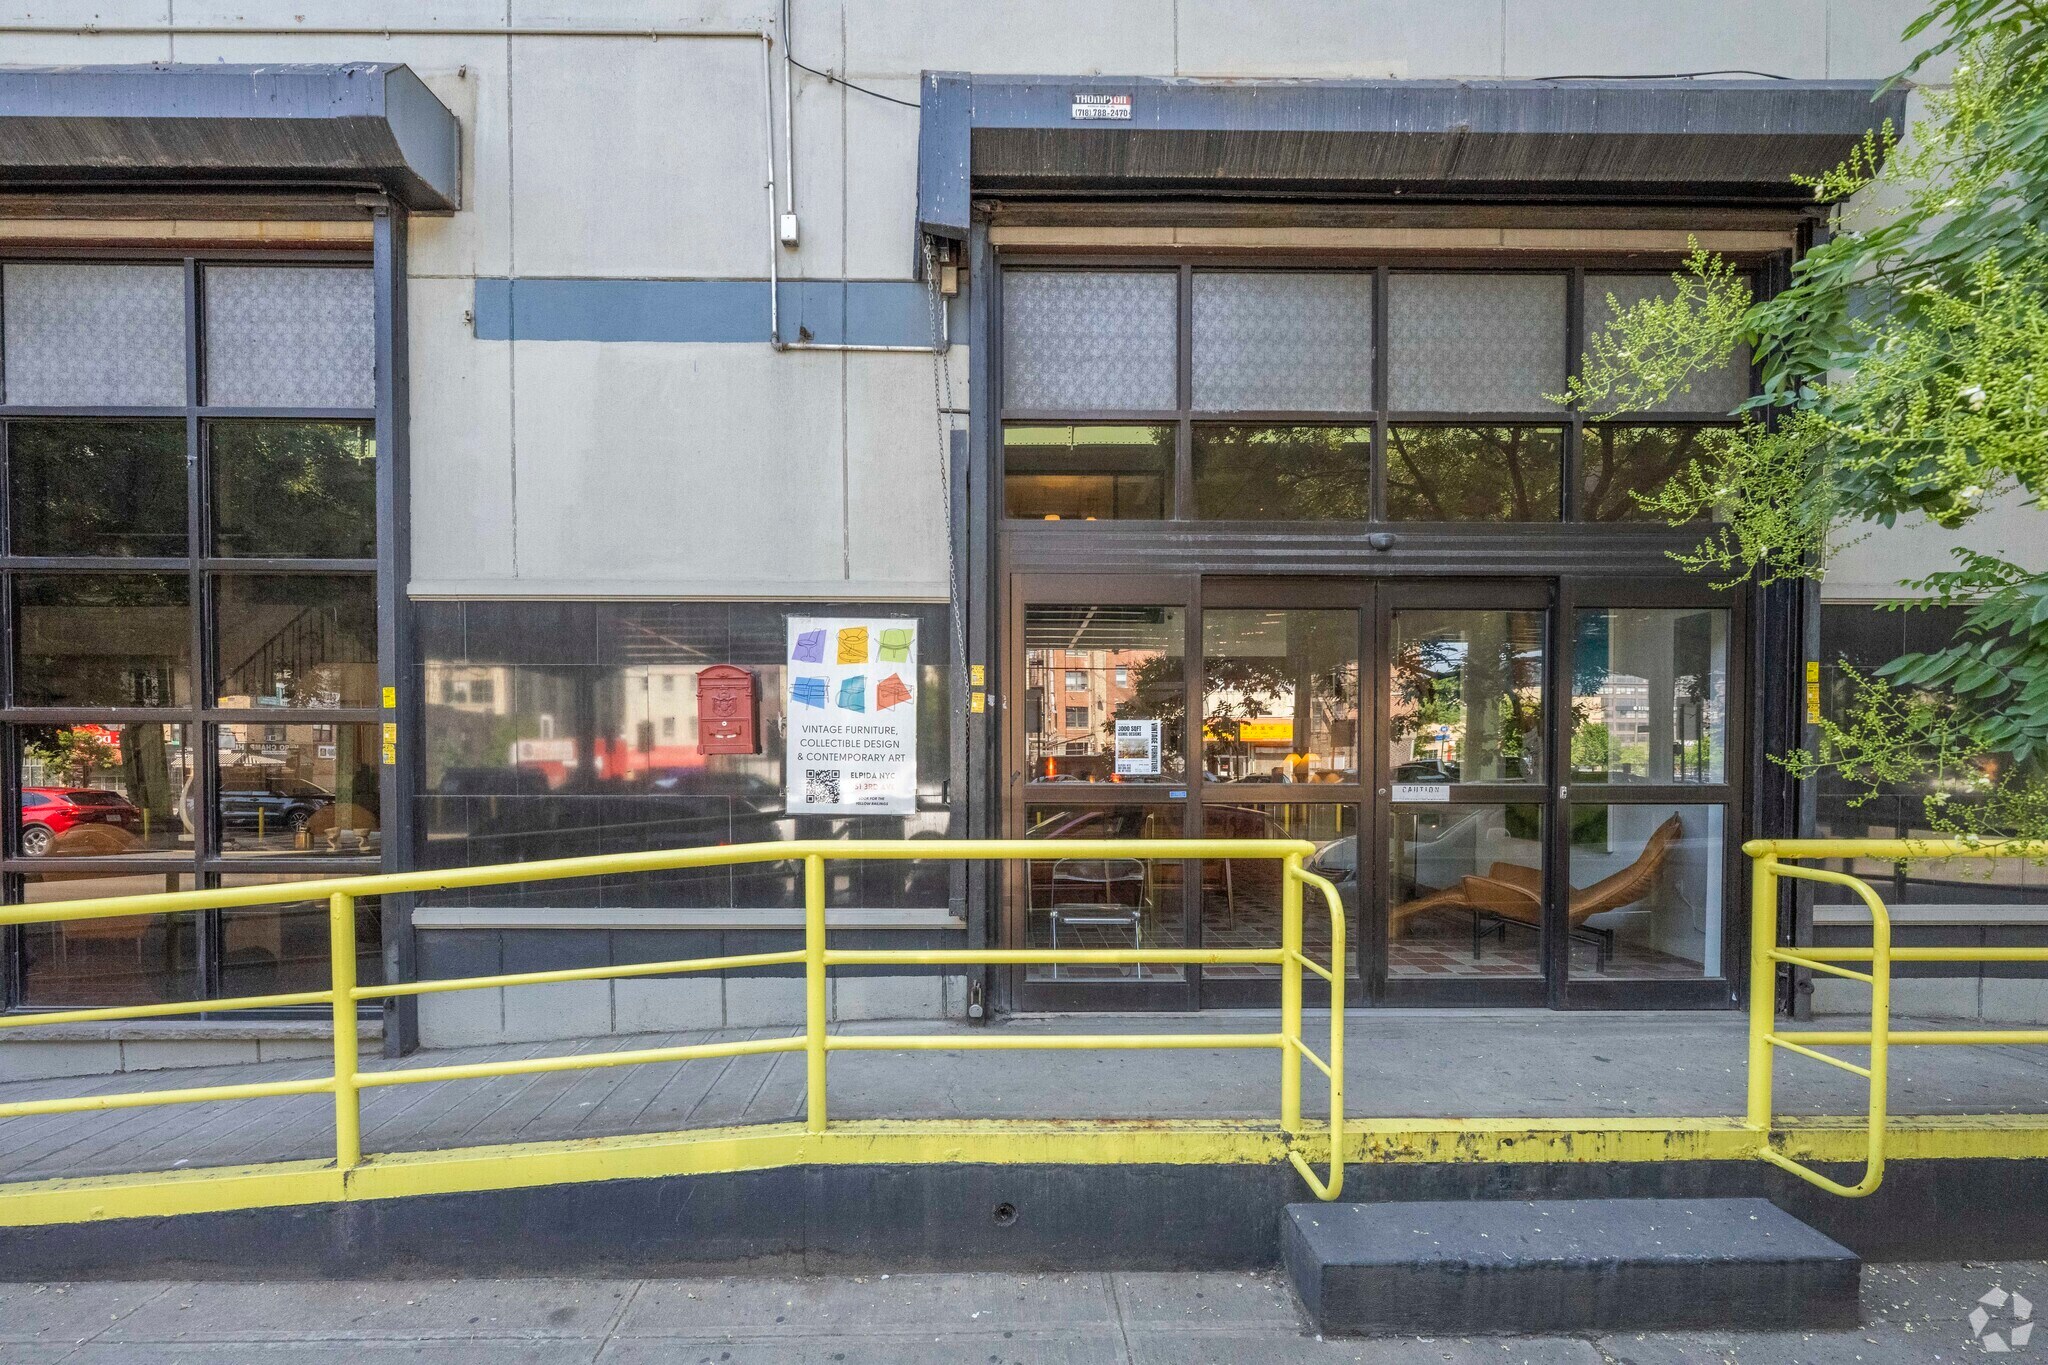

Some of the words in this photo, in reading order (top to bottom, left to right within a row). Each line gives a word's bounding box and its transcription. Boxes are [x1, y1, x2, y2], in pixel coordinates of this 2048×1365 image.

[1075, 108, 1092, 117] (718)
[802, 725, 842, 734] VINTAGE
[845, 726, 898, 735] FURNITURE,
[800, 739, 861, 748] COLLECTIBLE
[863, 740, 900, 748] DESIGN
[806, 753, 886, 762] CONTEMPORARY
[888, 754, 906, 762] ART
